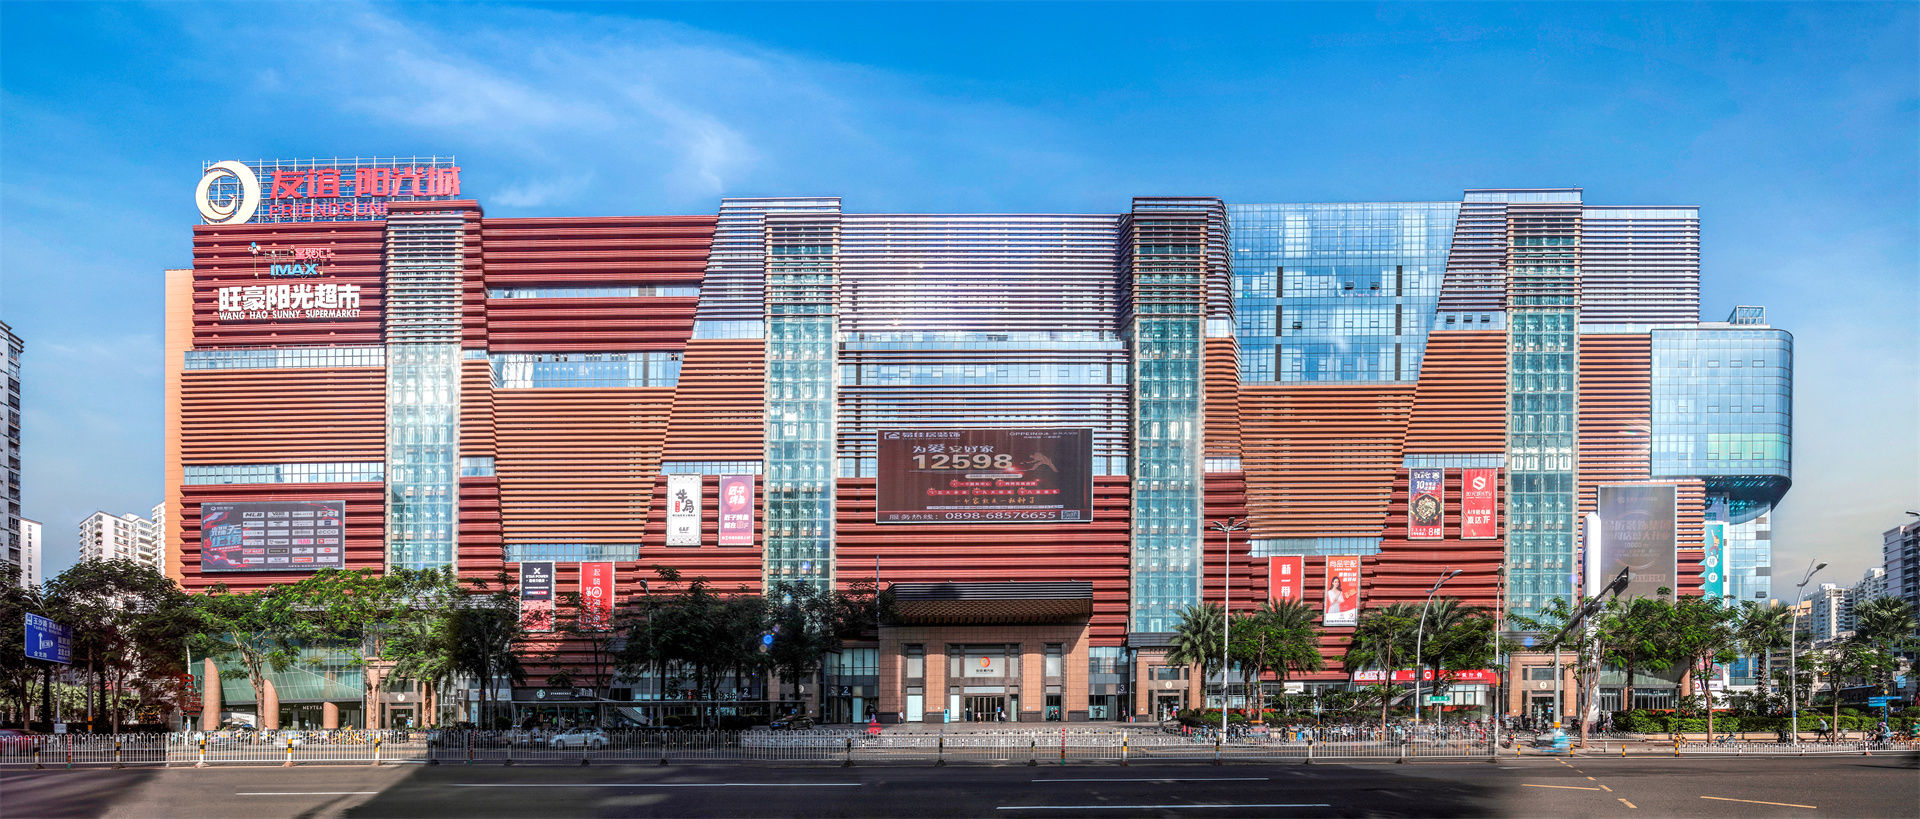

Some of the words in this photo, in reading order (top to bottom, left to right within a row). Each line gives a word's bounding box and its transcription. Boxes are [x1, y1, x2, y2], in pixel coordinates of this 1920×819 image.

[270, 263, 319, 276] IMAX
[219, 284, 361, 312] 旺豪阳光超市
[219, 311, 245, 321] WANG
[249, 311, 268, 320] HAO
[272, 310, 301, 319] SUNNY
[305, 309, 361, 319] SUPERMARKET
[912, 453, 1013, 470] 12598
[945, 511, 1056, 520] 0898-68576655
